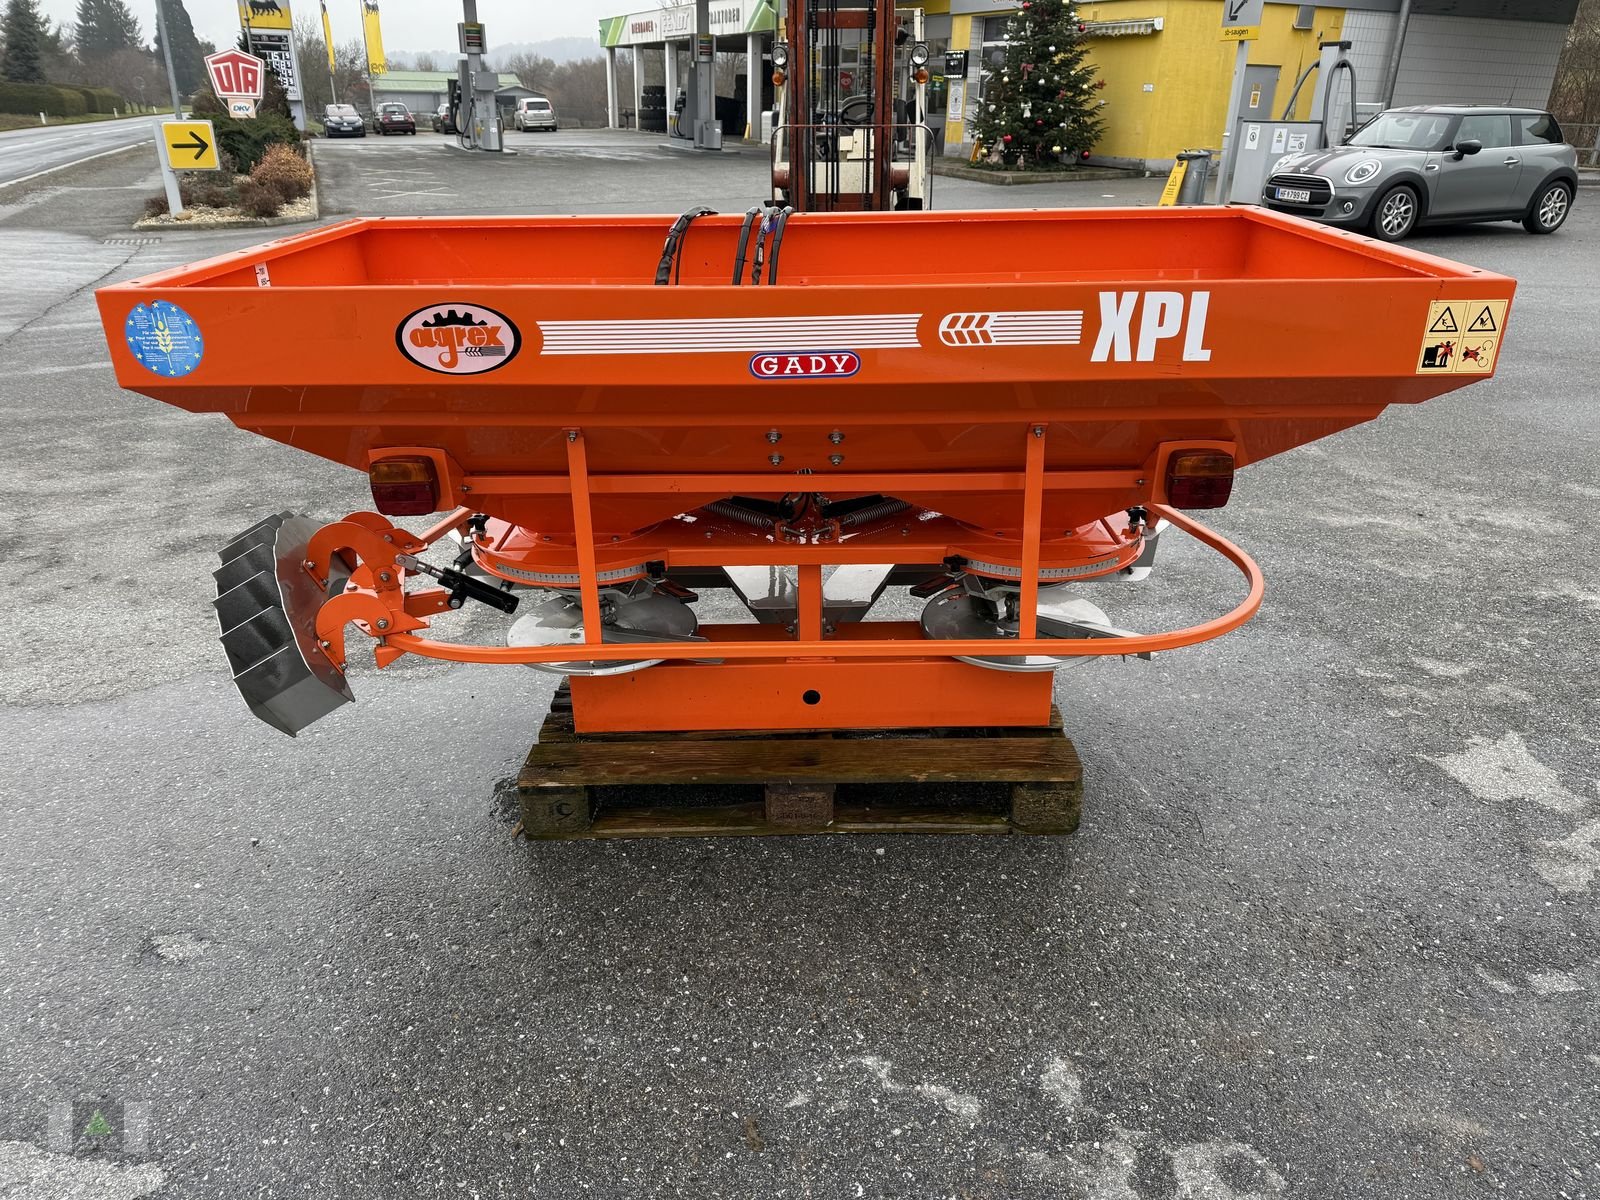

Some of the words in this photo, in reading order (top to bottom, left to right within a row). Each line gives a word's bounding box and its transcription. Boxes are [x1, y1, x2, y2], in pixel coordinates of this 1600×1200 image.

[210, 53, 259, 93] UTA
[409, 325, 505, 369] agrex
[1090, 291, 1211, 361] XPL
[760, 355, 849, 375] GADY
